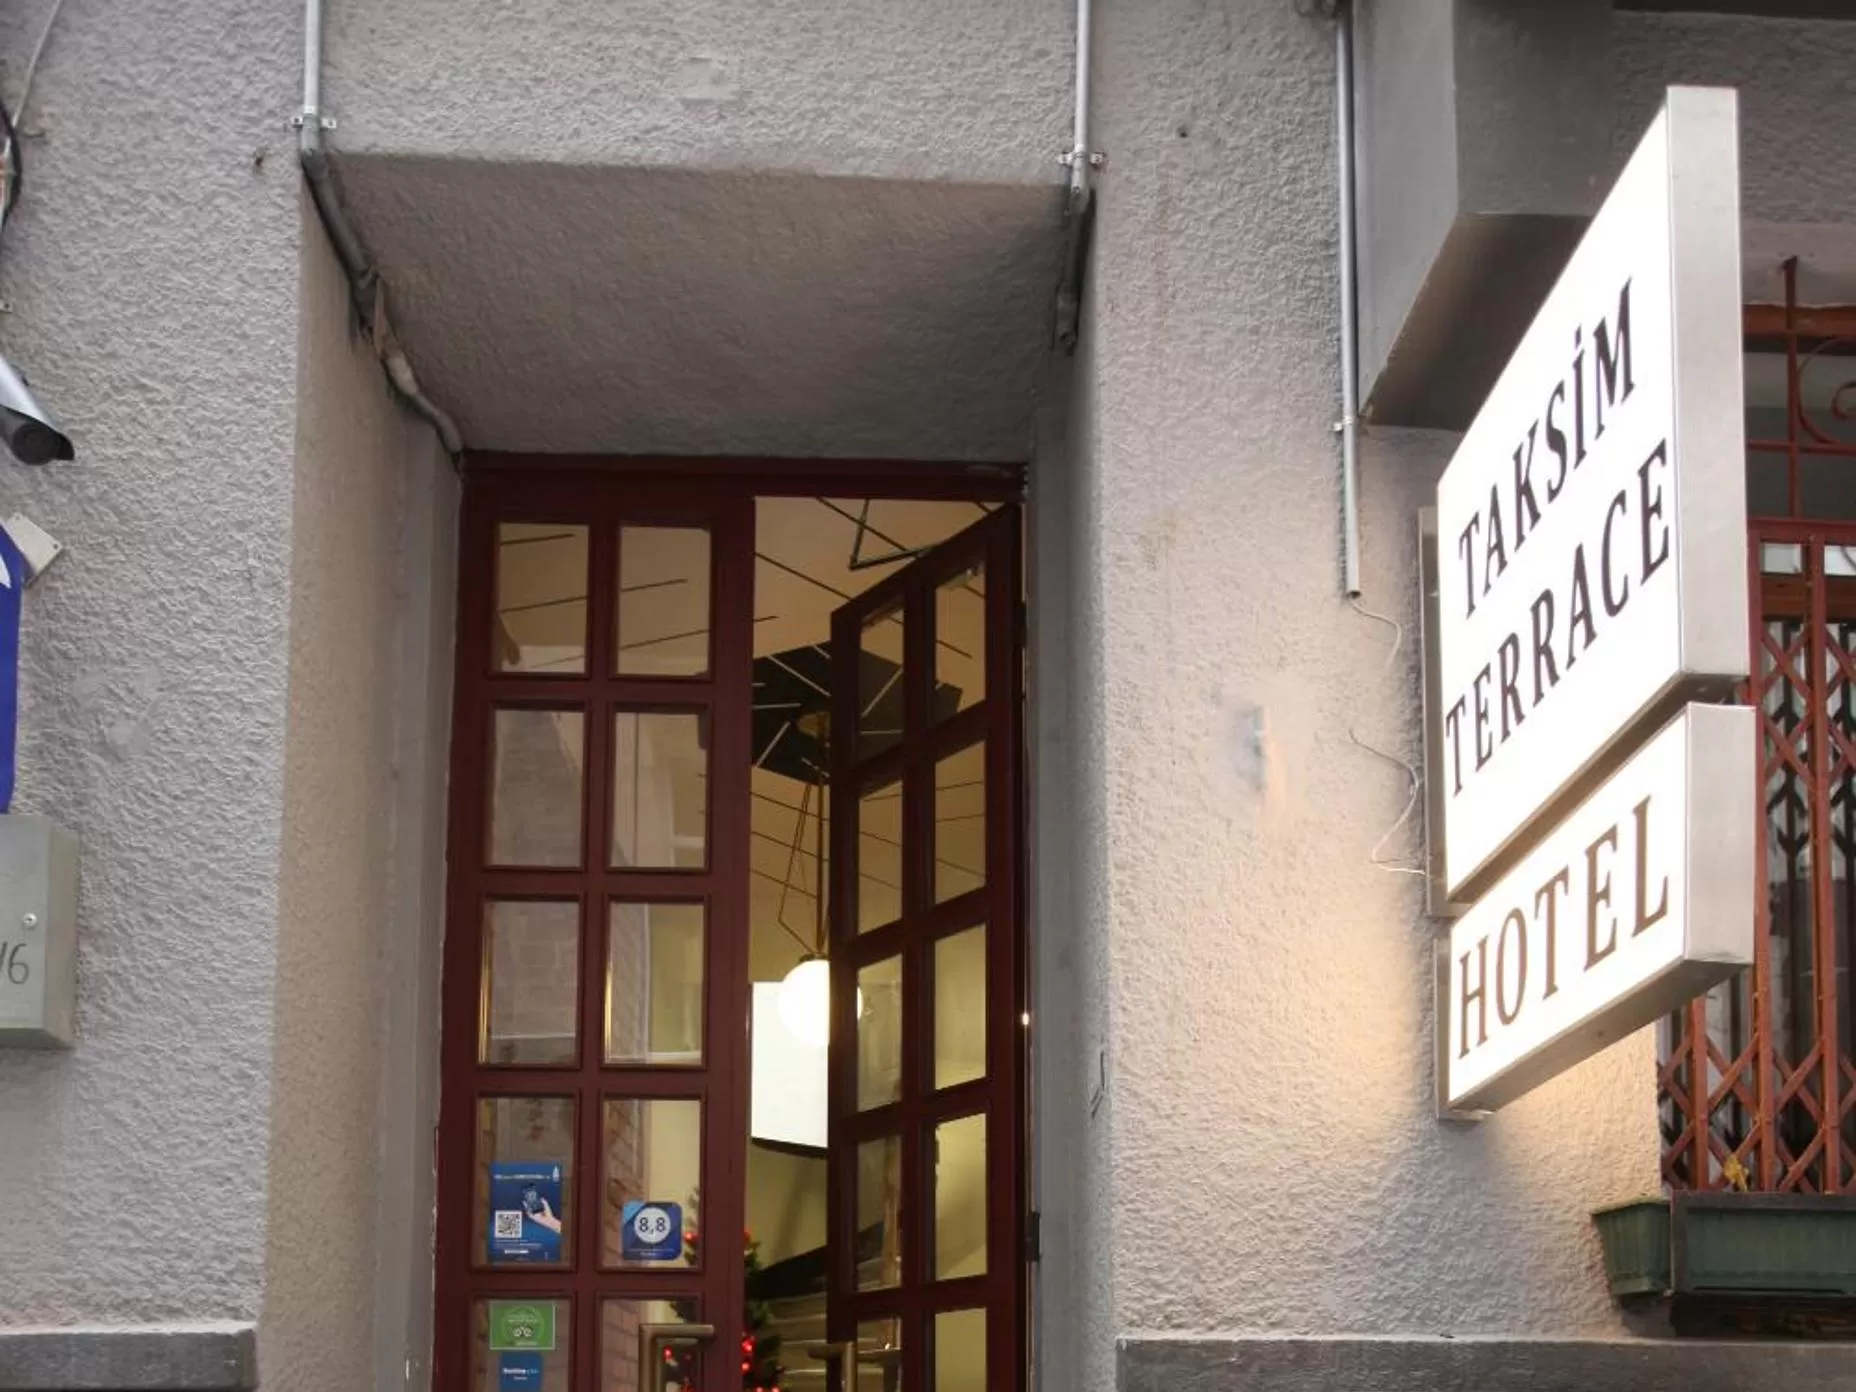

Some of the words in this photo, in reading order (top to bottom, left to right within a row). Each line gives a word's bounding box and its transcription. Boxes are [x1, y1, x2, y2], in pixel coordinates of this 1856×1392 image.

[1446, 438, 1669, 798] TERRACE
[1459, 276, 1635, 620] TAKSİM
[1459, 795, 1668, 1059] HOTEL
